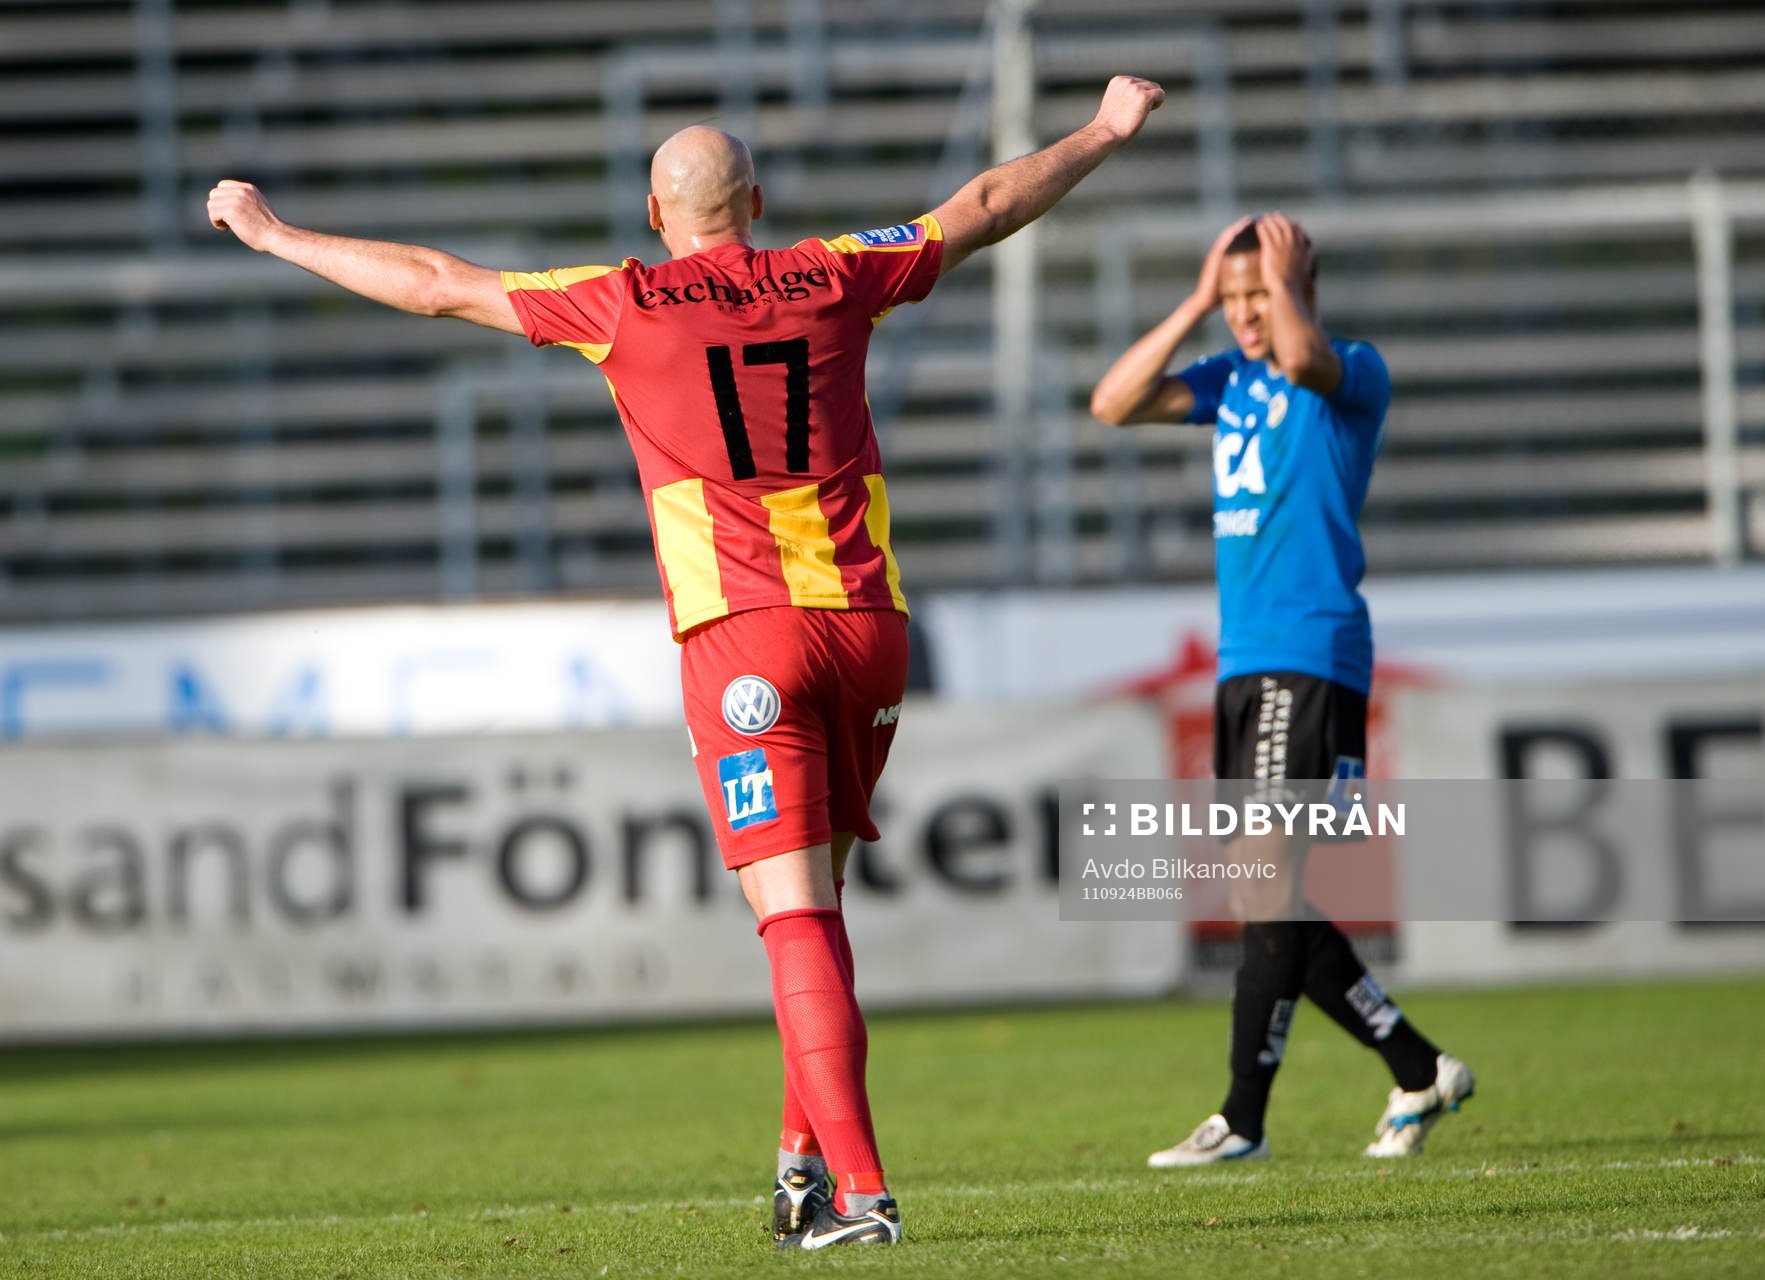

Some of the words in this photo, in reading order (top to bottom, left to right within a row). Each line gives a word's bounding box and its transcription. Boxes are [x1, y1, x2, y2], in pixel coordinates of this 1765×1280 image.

[634, 267, 829, 309] exchange
[706, 338, 809, 481] 17
[724, 768, 773, 822] LT
